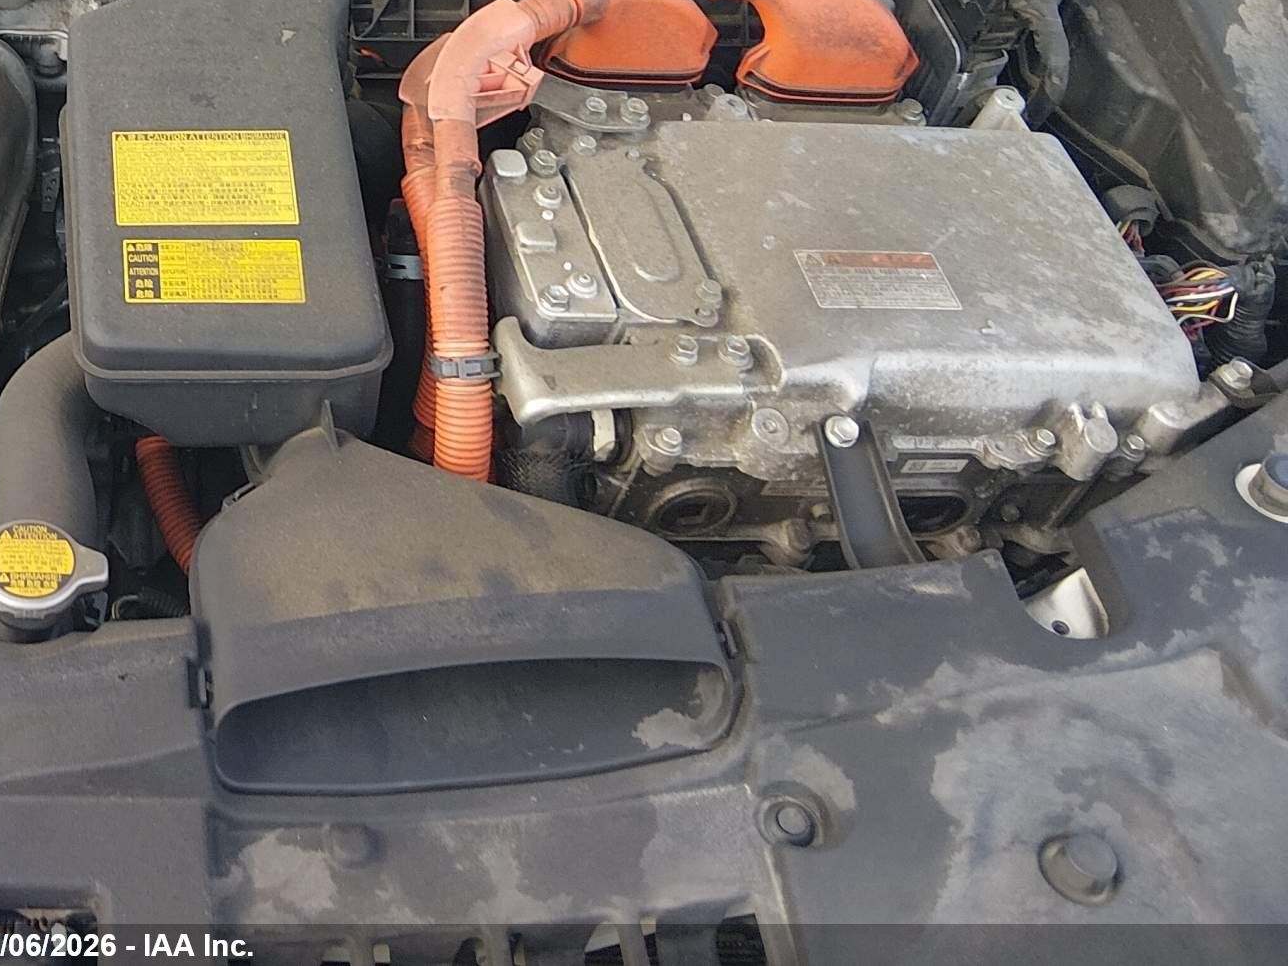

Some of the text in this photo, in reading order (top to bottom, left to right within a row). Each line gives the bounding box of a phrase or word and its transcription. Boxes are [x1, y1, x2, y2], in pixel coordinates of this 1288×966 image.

[147, 133, 186, 141] CAUTION
[128, 254, 158, 263] CAUTION
[129, 267, 159, 276] ATTENTION
[13, 524, 47, 533] CAUTION
